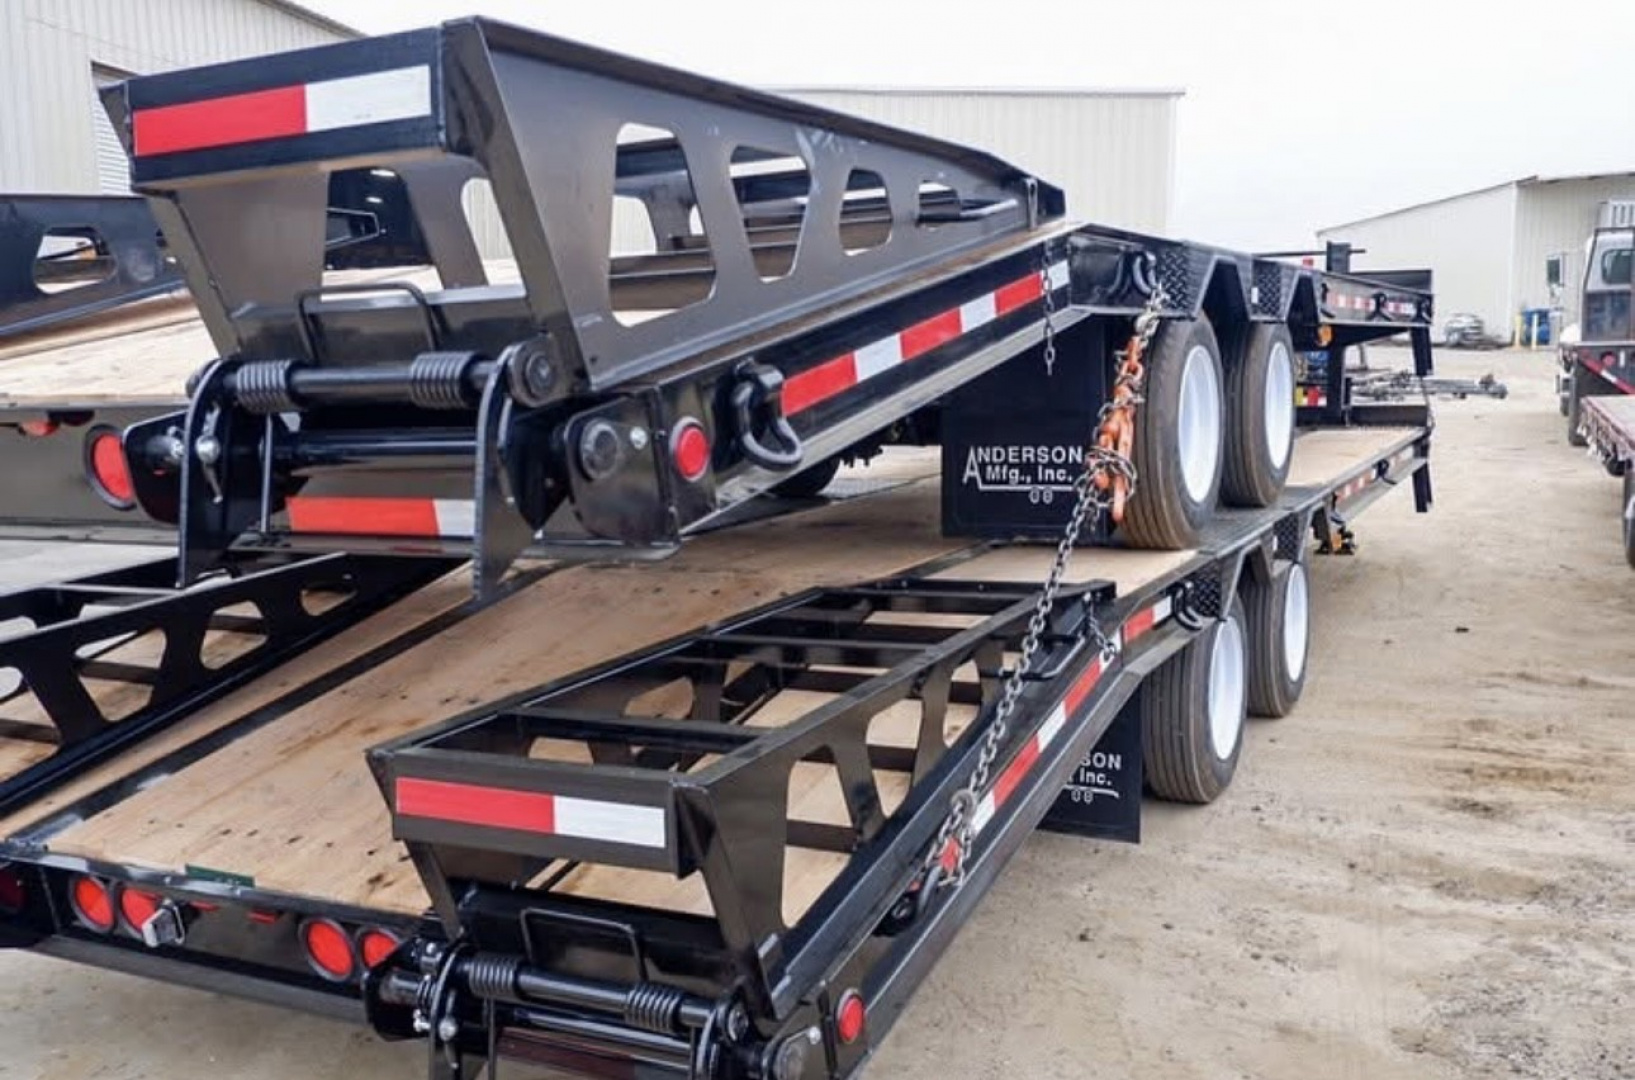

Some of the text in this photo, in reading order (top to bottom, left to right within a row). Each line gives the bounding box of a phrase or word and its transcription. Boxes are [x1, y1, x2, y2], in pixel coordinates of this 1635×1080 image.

[962, 445, 1083, 485] ANDERSON
[986, 464, 1073, 484] Mfg., Inc.
[1079, 767, 1111, 786] Inc.
